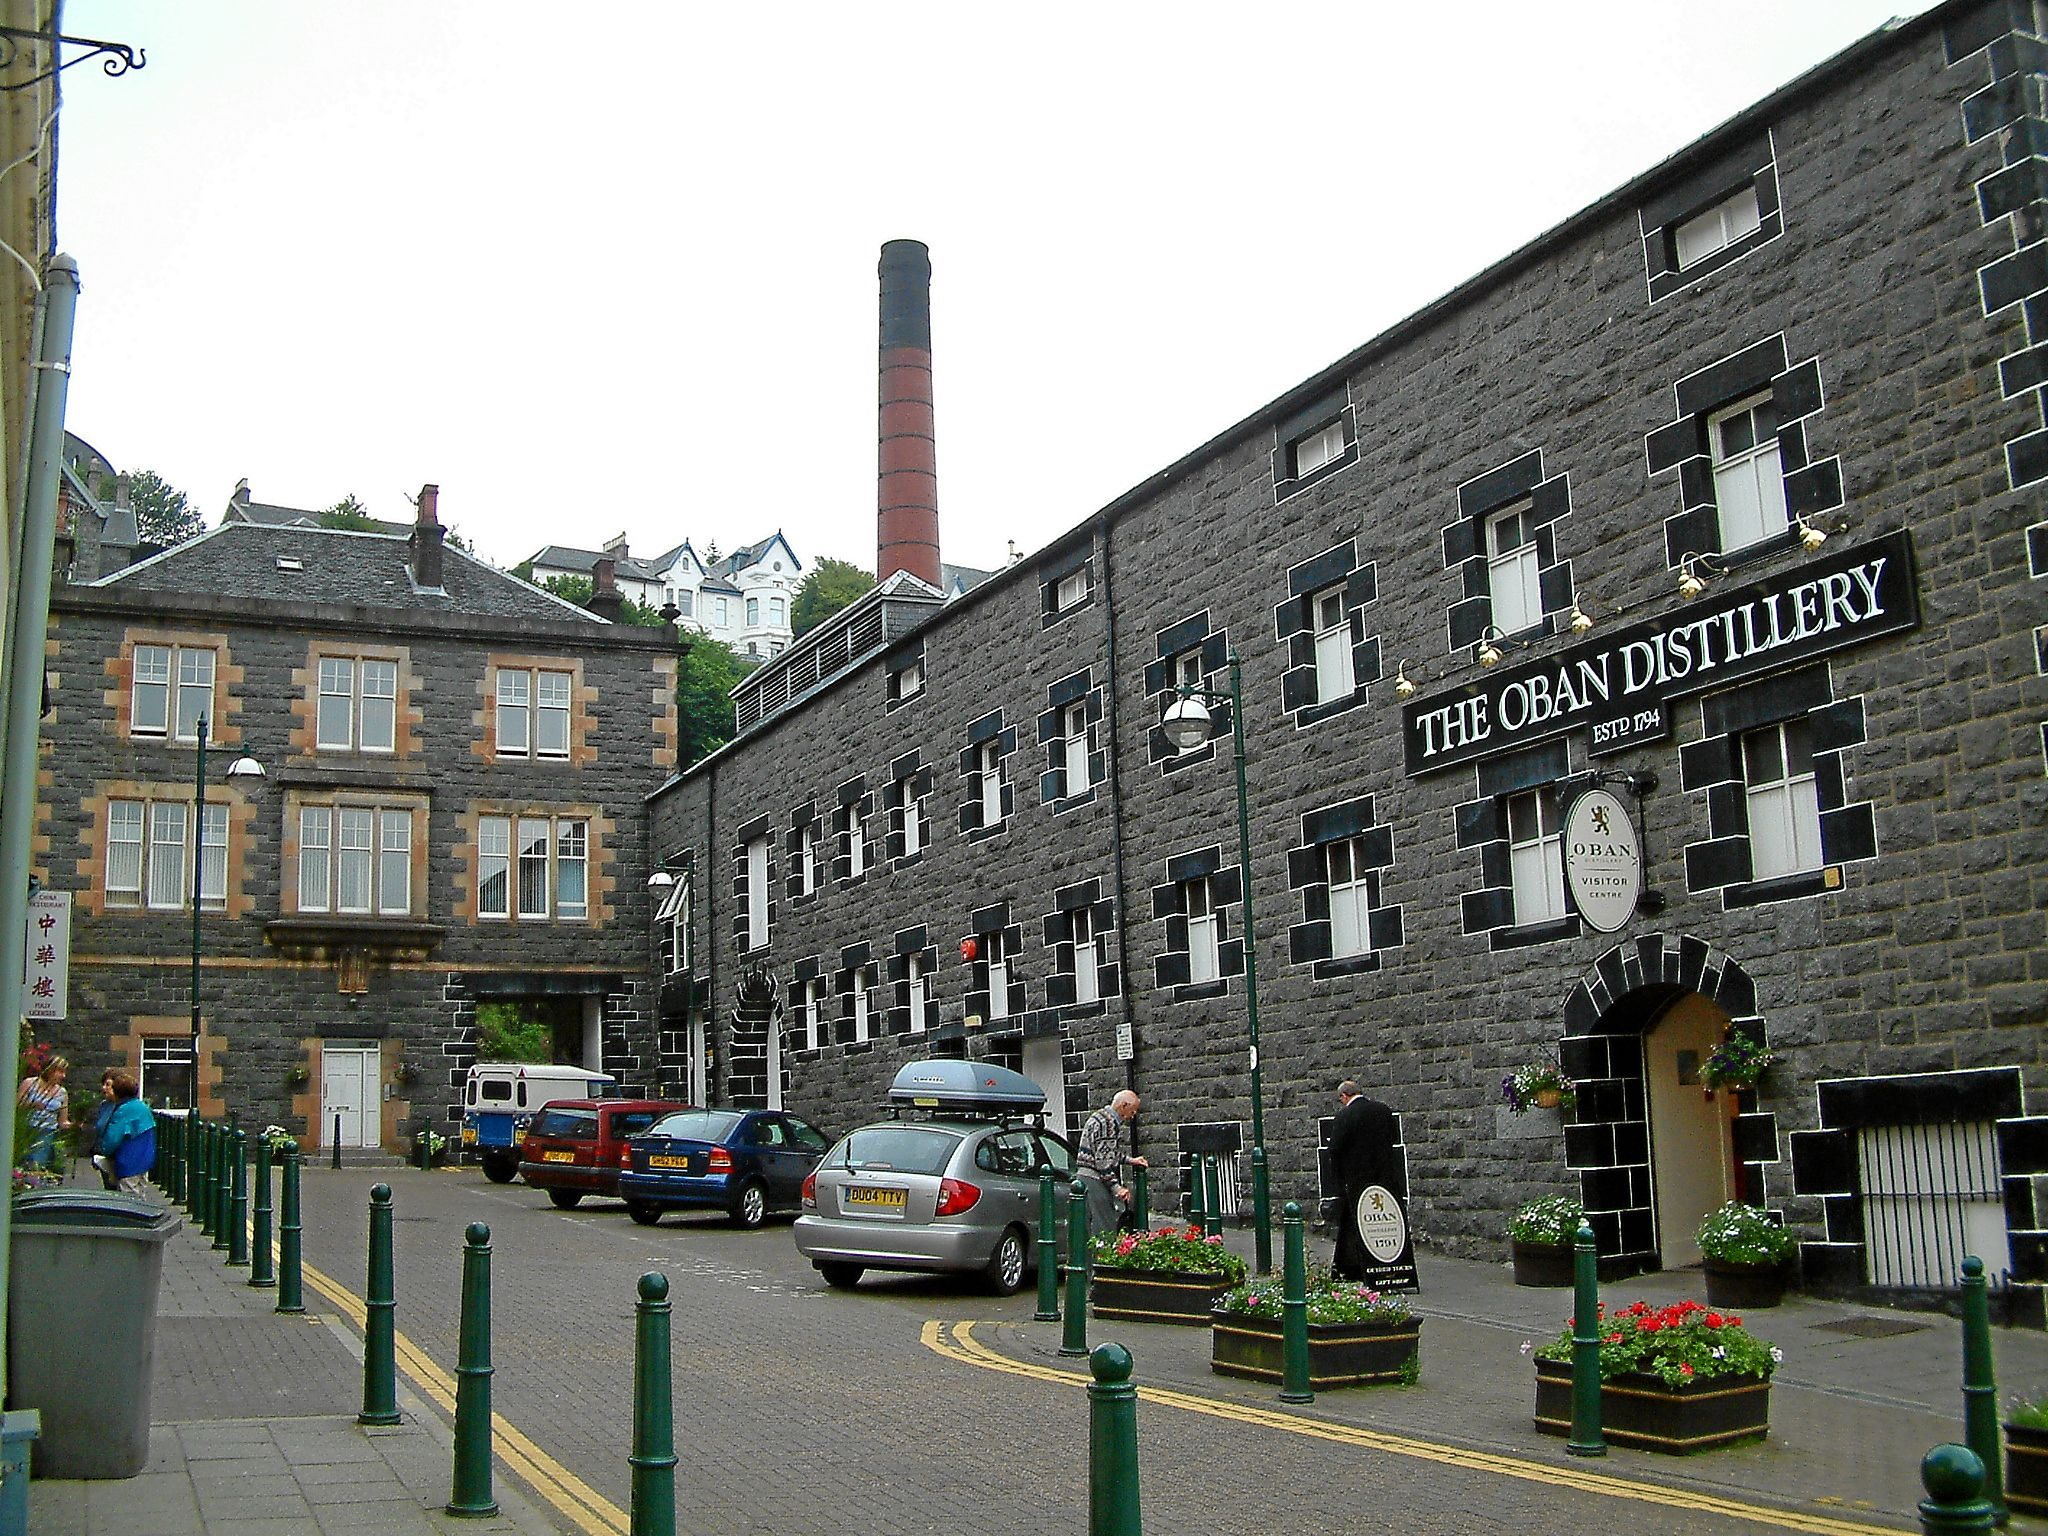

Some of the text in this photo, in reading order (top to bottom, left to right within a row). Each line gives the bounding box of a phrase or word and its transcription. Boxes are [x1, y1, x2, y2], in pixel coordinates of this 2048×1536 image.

[1416, 557, 1887, 757] THE OBAN DISTILLERY
[1633, 708, 1661, 733] 1794
[1573, 843, 1631, 857] OBAN
[1581, 877, 1628, 887] VISITOR
[1589, 891, 1623, 899] CENTRE
[1363, 1213, 1397, 1222] OBAN
[1374, 1238, 1397, 1248] 1794
